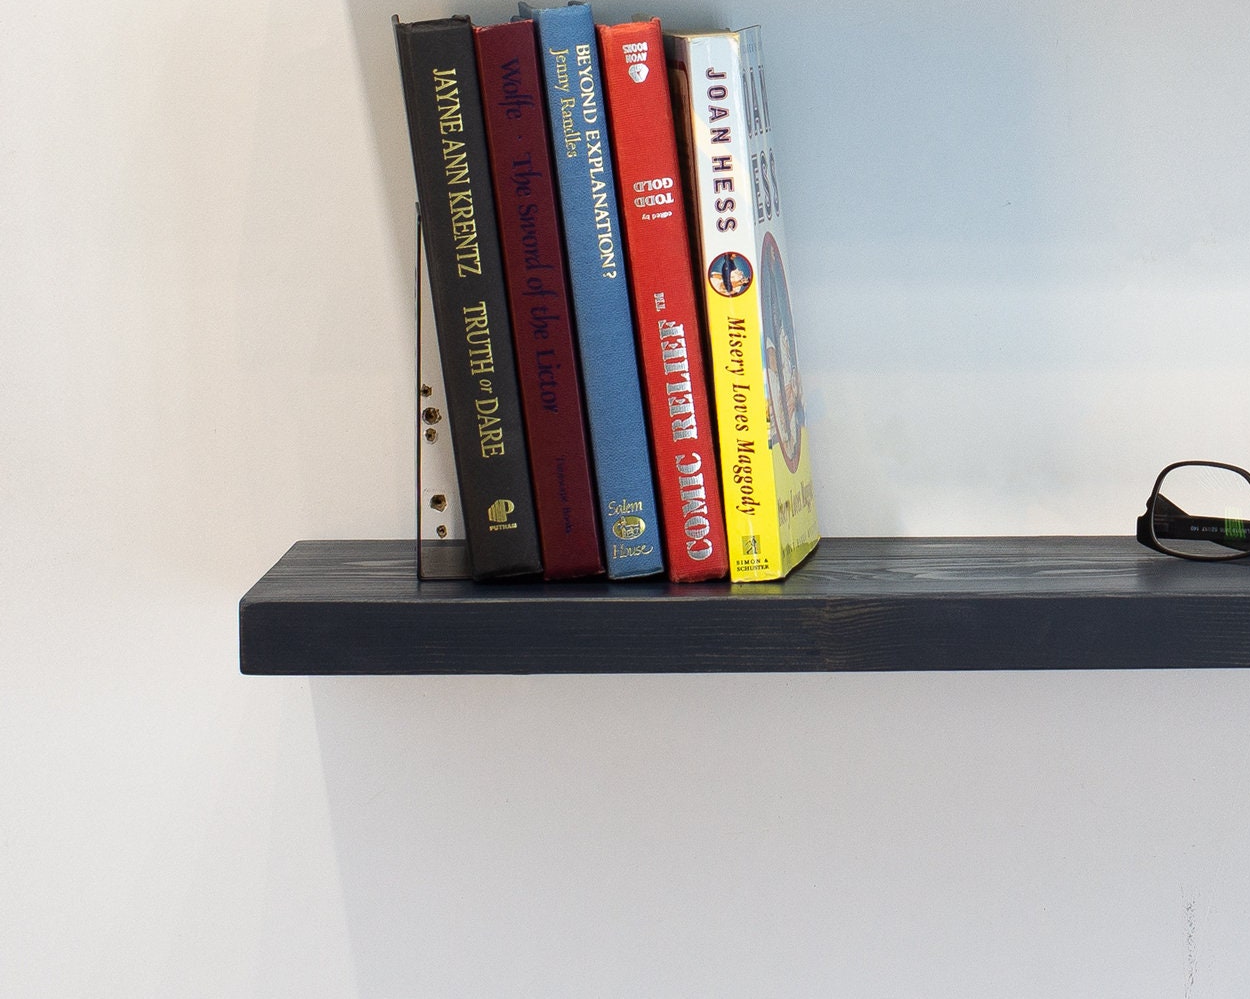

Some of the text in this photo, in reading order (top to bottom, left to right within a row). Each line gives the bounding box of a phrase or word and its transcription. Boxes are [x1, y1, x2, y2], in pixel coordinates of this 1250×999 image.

[575, 44, 598, 124] BEYOND
[622, 42, 648, 54] BOOKS
[626, 52, 647, 63] AVON
[550, 47, 581, 158] Jenny Randles
[433, 68, 482, 278] JAYNE ANN KRENTZ
[633, 177, 673, 192] GOLD
[705, 67, 738, 233] JOAN HESS
[498, 57, 561, 414] Wolfe The Sword of the Lictor
[634, 192, 674, 208] TODD
[641, 211, 673, 221] edited by
[463, 301, 505, 458] TRUTH or DARE
[658, 319, 698, 442] RELIEF
[725, 316, 760, 516] Misery Loves Maggody
[608, 499, 643, 516] Salem
[612, 543, 653, 559] House
[675, 452, 713, 561] COMIC
